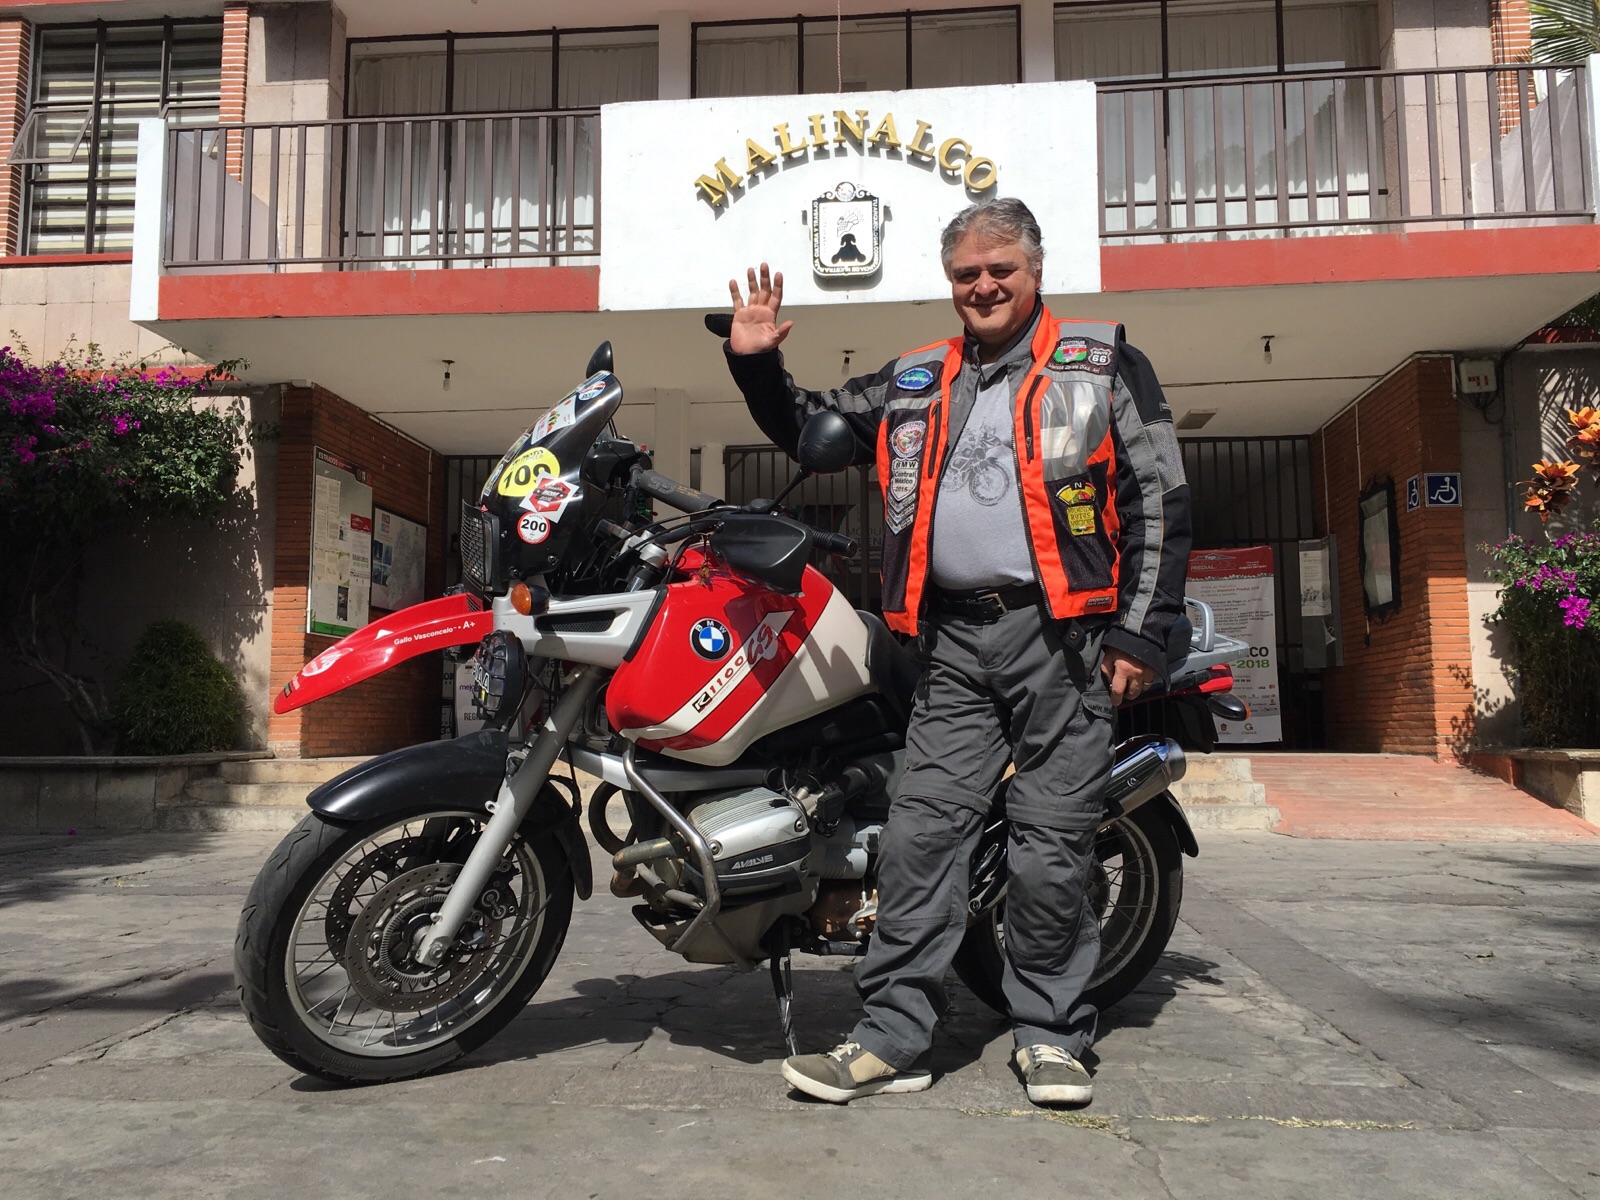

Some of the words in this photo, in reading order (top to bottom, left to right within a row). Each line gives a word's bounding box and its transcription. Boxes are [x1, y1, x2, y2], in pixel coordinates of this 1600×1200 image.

[694, 109, 998, 208] MALINALCO
[1092, 354, 1107, 363] 66
[521, 519, 547, 533] 200
[393, 636, 413, 645] Gallo
[463, 620, 476, 630] A+
[695, 620, 727, 634] BMW
